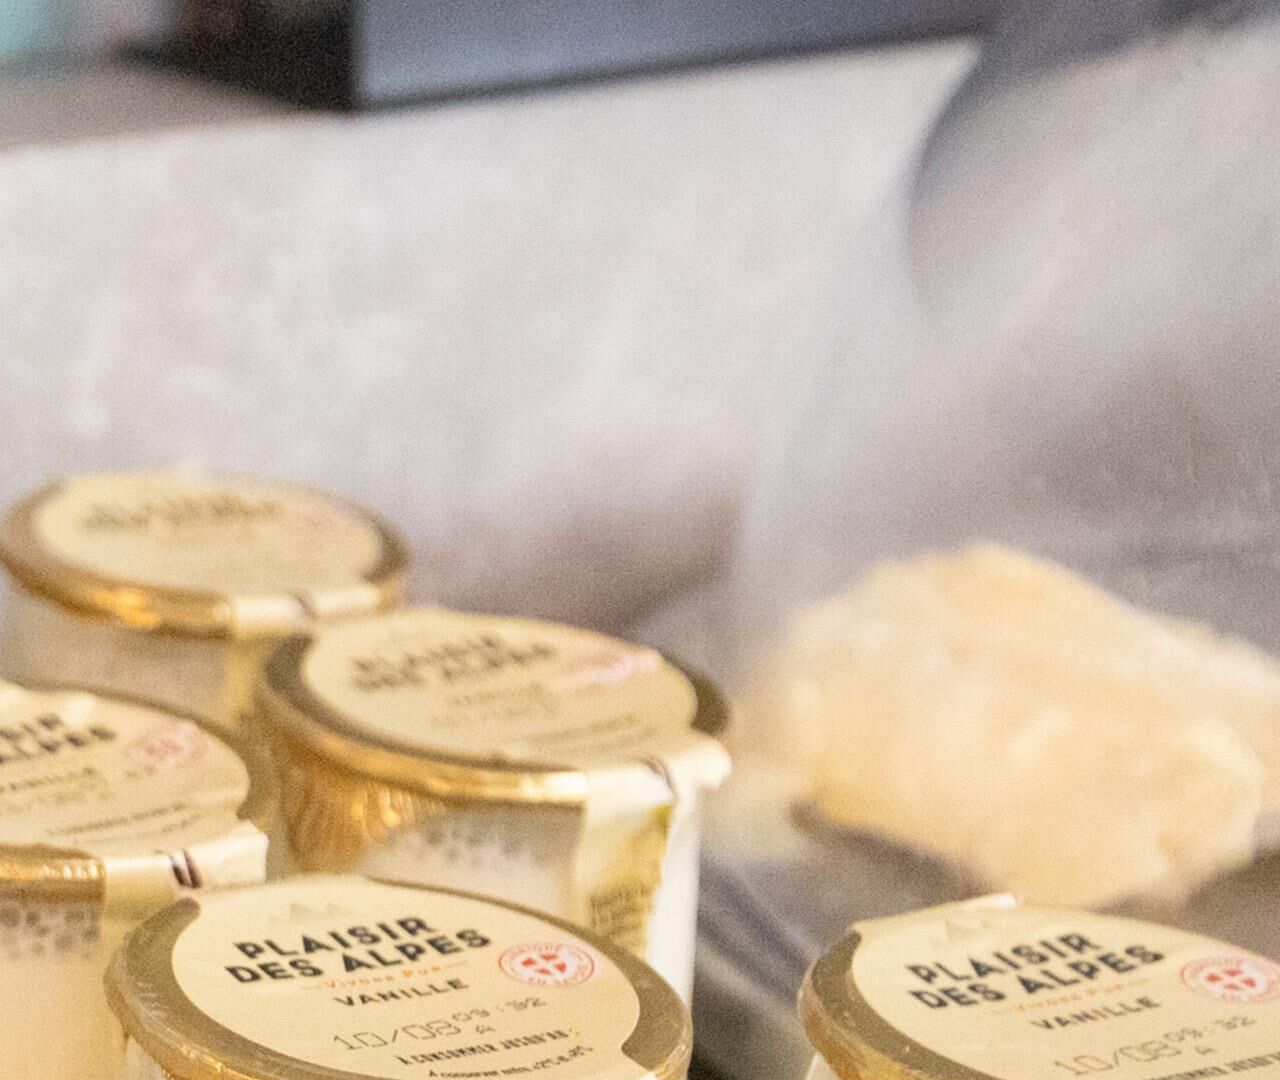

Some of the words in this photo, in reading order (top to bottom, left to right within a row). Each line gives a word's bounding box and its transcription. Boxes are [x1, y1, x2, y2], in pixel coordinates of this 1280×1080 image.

[225, 959, 323, 983] DES
[342, 929, 491, 972] ALPES
[233, 917, 436, 959] PLAISIR
[906, 931, 1101, 985] PLAISIR
[907, 982, 1006, 1010] DES
[1019, 943, 1166, 996] ALPES
[334, 978, 468, 1006] VANILLE
[1031, 996, 1161, 1031] VANILLE
[333, 1020, 461, 1051] 10/08
[411, 1043, 499, 1064] CONSOMMER
